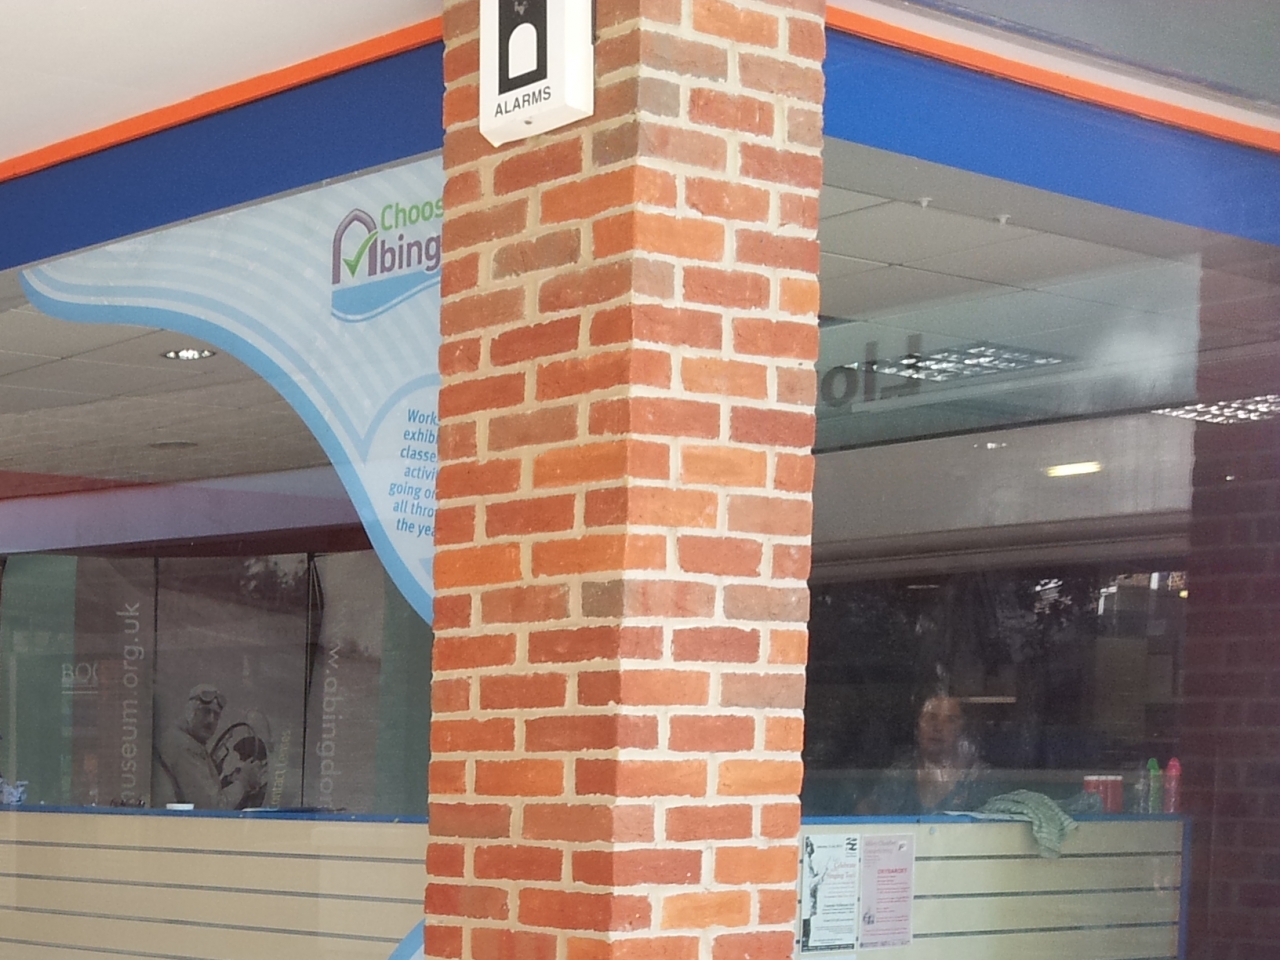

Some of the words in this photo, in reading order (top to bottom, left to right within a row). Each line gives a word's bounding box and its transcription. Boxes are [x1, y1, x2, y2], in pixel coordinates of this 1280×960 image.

[494, 86, 552, 118] ALARMS
[408, 408, 439, 426] Work
[400, 445, 438, 463] classe
[388, 481, 422, 501] going
[393, 499, 408, 514] all
[410, 501, 434, 518] thro
[396, 517, 415, 533] the
